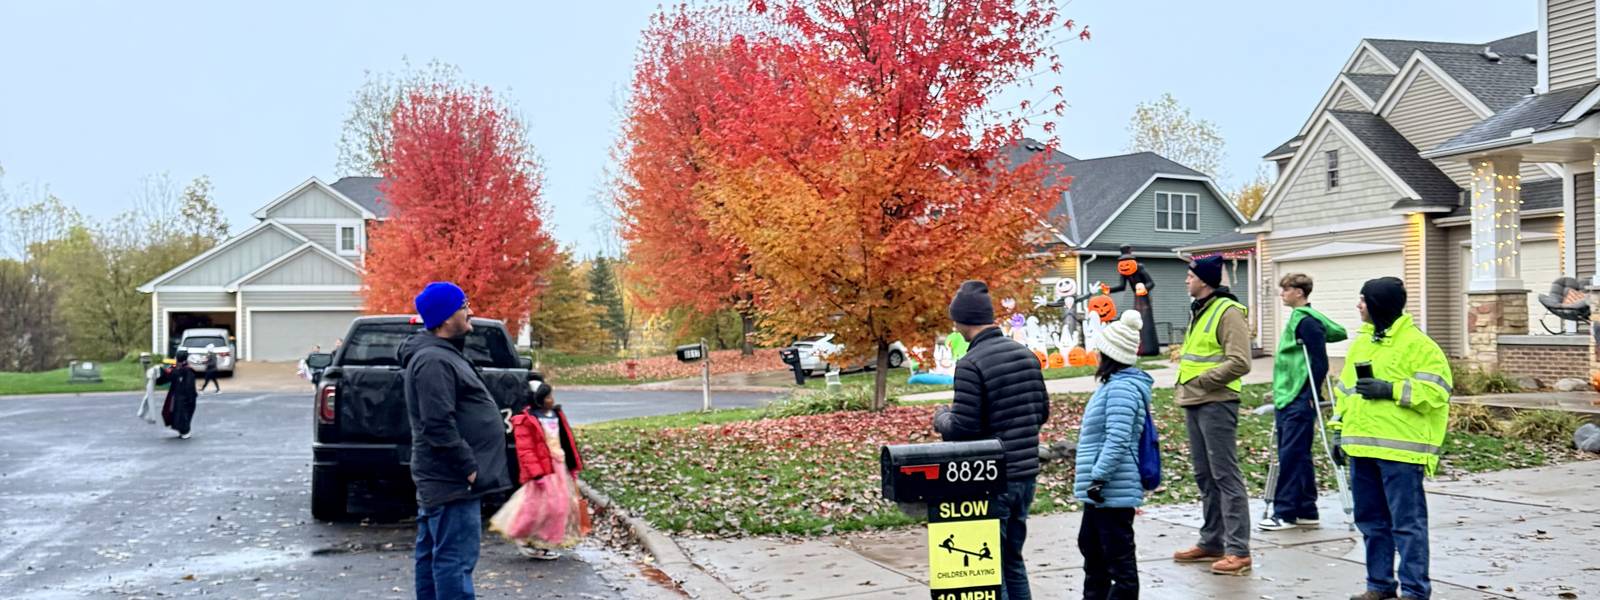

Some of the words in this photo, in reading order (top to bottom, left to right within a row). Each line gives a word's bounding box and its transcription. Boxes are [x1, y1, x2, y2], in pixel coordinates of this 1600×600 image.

[946, 460, 998, 482] 8825
[939, 500, 989, 518] SLOW
[937, 571, 968, 579] CHILDREN
[960, 590, 996, 600] MPH
